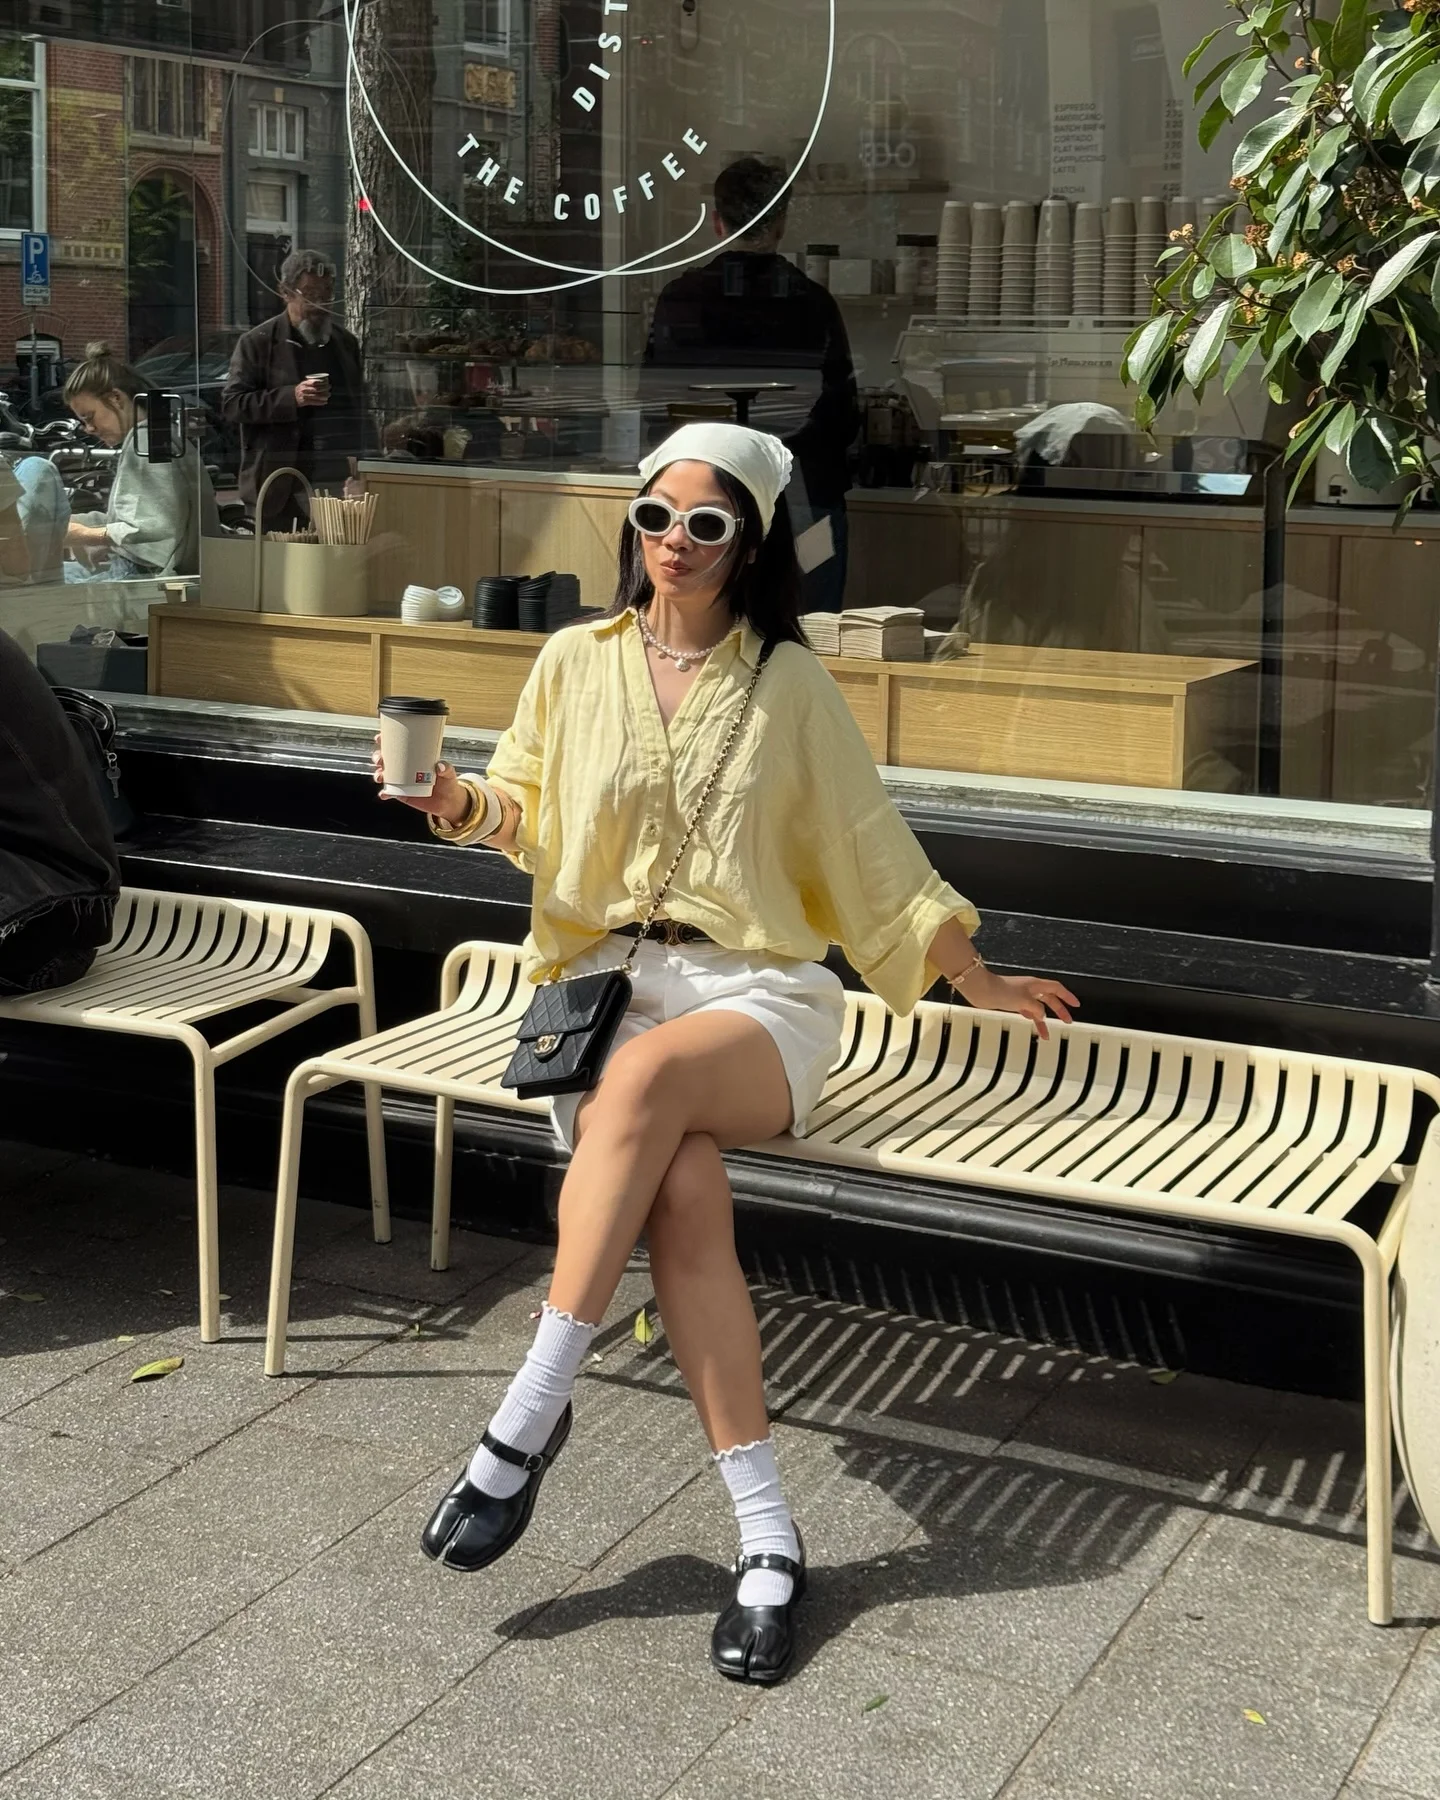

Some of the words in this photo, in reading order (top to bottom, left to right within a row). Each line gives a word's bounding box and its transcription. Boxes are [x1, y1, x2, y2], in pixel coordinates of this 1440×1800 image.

[571, 0, 628, 112] DIST
[456, 133, 524, 204] THE
[553, 127, 708, 221] COFFEE
[29, 237, 44, 264] P
